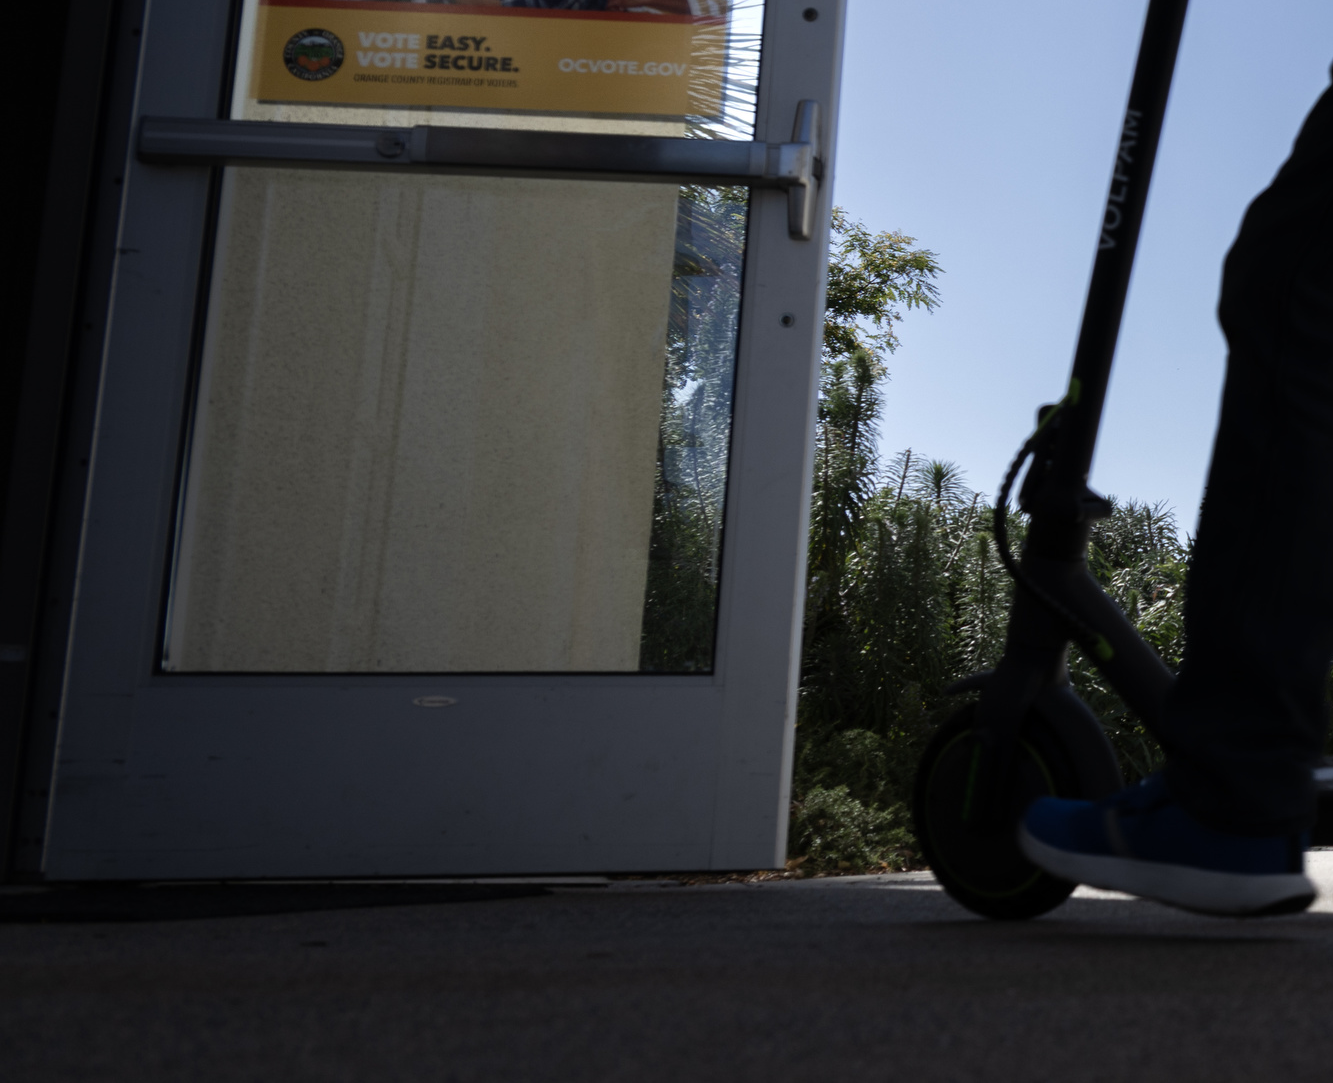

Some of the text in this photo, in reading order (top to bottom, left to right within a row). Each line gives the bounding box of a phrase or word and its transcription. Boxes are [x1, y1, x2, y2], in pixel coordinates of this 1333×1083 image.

[357, 31, 491, 52] VOTE EASY.
[356, 51, 520, 72] VOTE SECURE.
[558, 58, 687, 76] OCVOTE.GOV
[353, 73, 389, 84] ORANGE
[391, 74, 425, 85] COUNTY
[1097, 108, 1142, 251] VOLPAM
